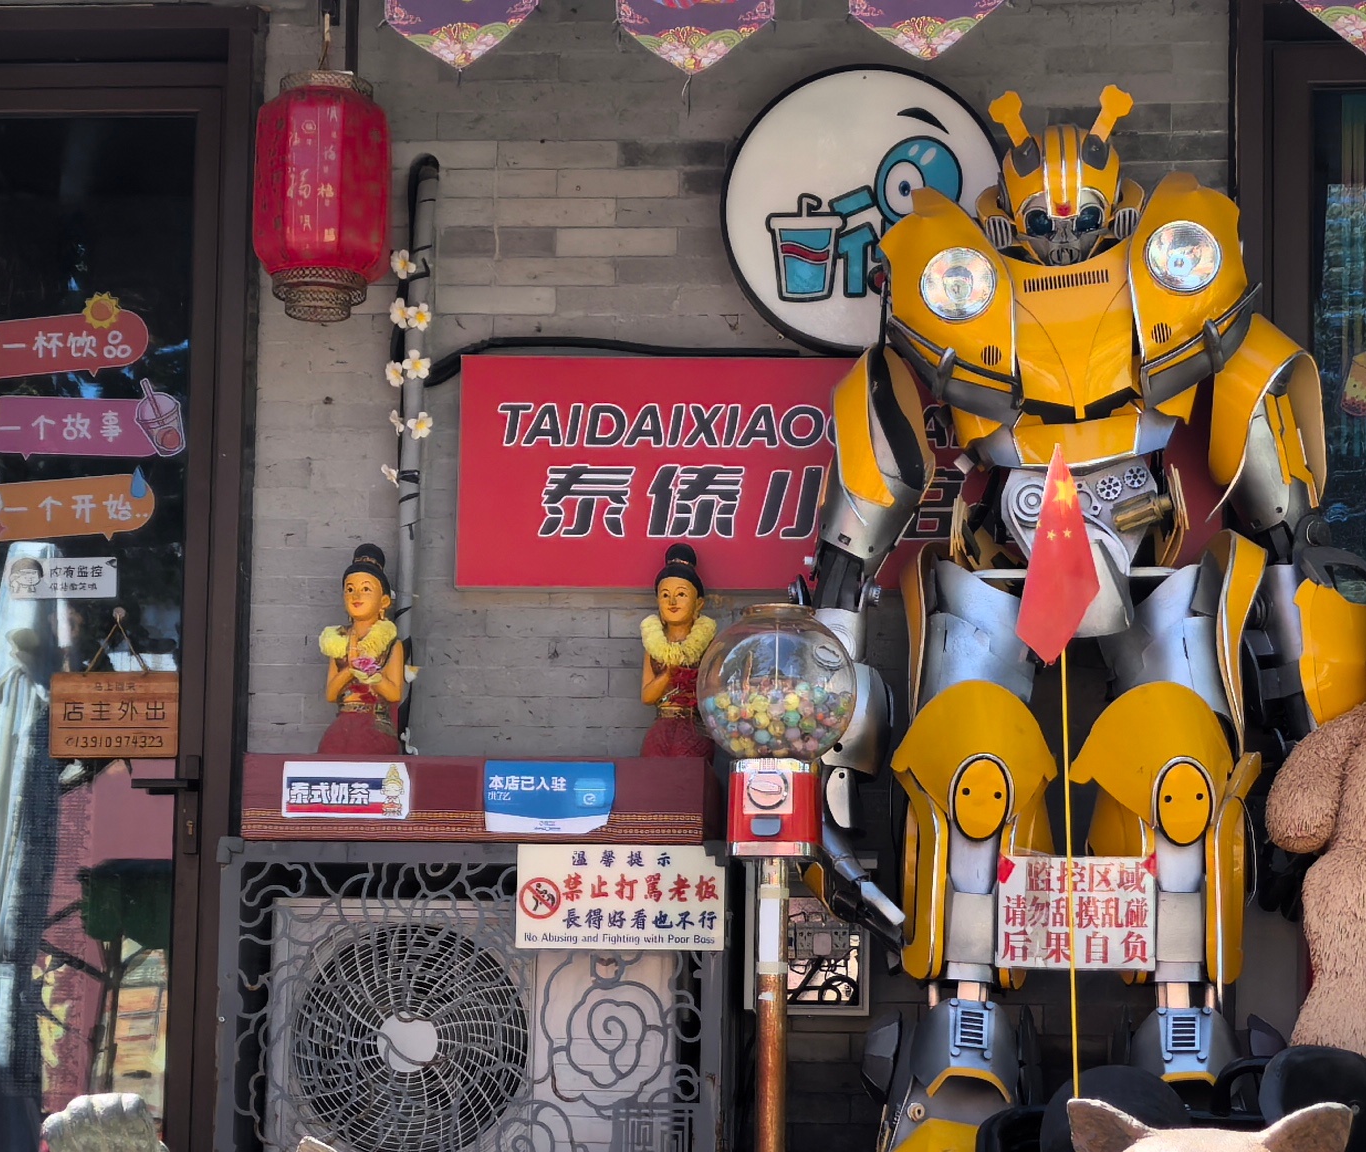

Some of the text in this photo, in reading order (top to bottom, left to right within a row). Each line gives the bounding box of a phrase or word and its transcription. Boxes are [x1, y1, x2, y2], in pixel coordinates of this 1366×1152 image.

[2, 330, 133, 359] 一杯饮品
[50, 565, 104, 578] 内有监控
[63, 701, 166, 721] 店主外出
[289, 782, 370, 805] 泰式奶茶
[488, 774, 567, 791] 本店已入驻
[1026, 860, 1147, 894] 监控区域
[562, 908, 718, 930] 長得好看也不行
[1001, 894, 1149, 929] 请勿乱摸乱碰
[524, 933, 538, 942] No
[541, 932, 578, 944] Abusing
[581, 933, 598, 943] and
[602, 933, 640, 945] Fighting
[643, 934, 664, 944] with
[667, 935, 689, 944] Poor
[1001, 929, 1149, 965] 后果自负
